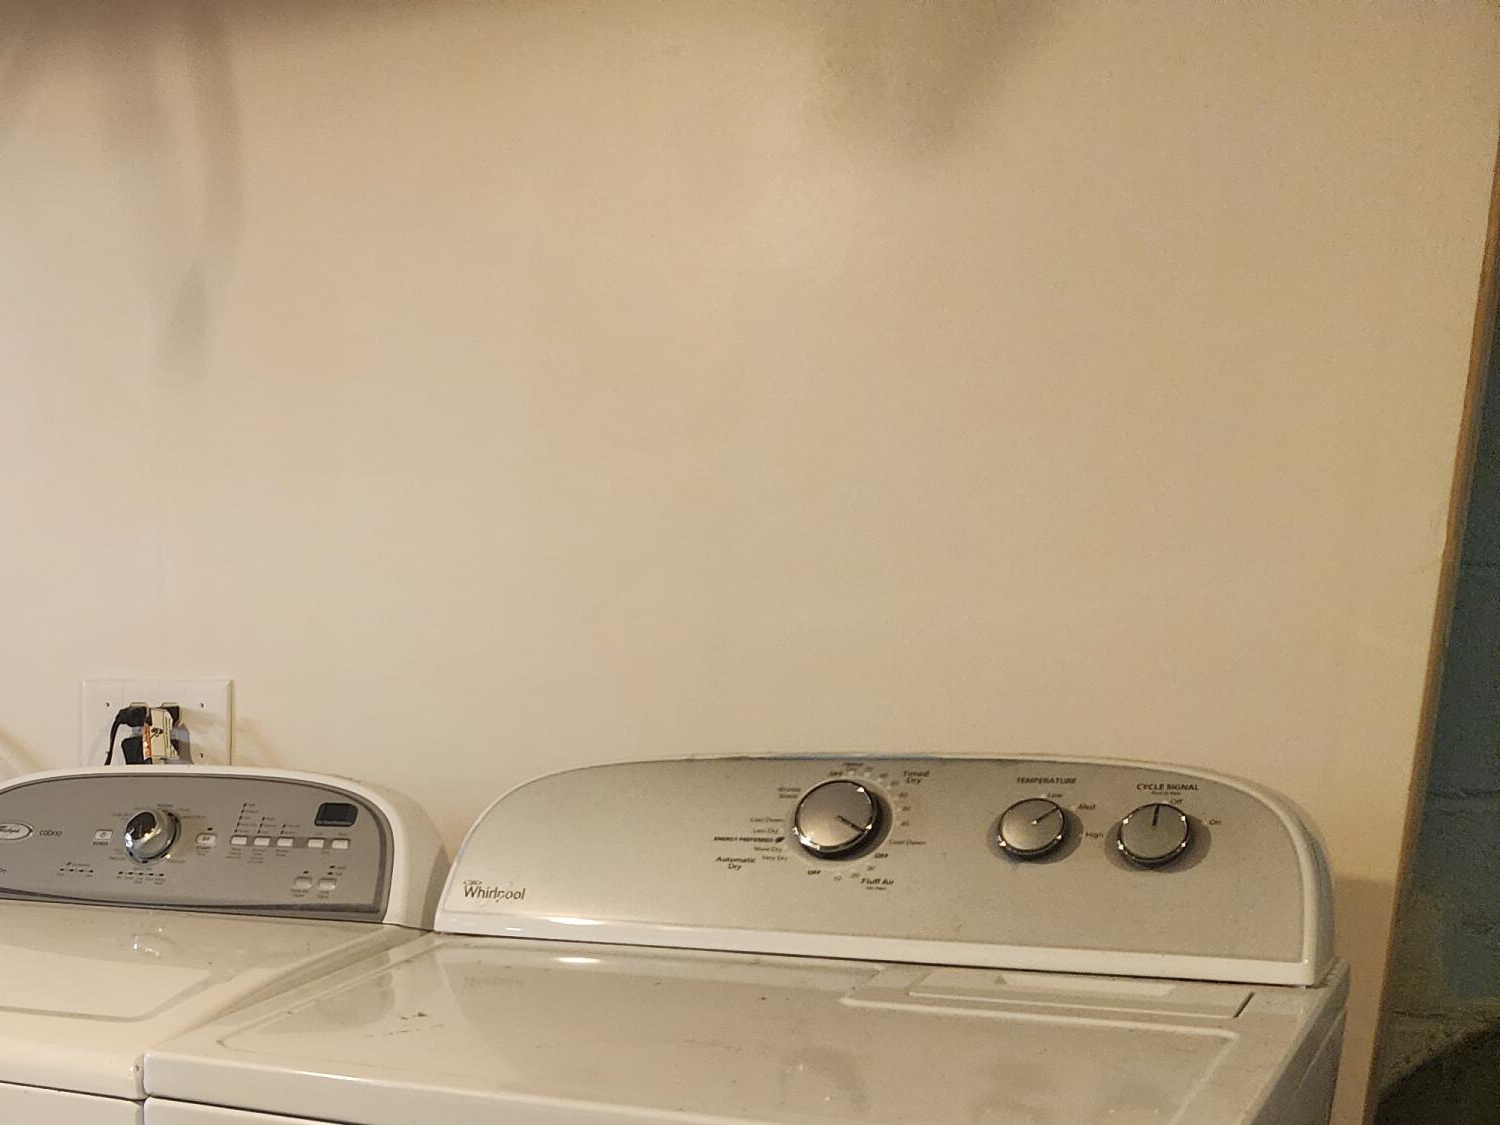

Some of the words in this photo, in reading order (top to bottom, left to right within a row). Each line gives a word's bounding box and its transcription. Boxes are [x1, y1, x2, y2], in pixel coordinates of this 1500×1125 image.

[1016, 777, 1077, 785] TEMPERATURE
[1166, 783, 1199, 791] SIGNAL
[728, 863, 742, 871] Dry
[464, 886, 526, 903] Whirlpool
